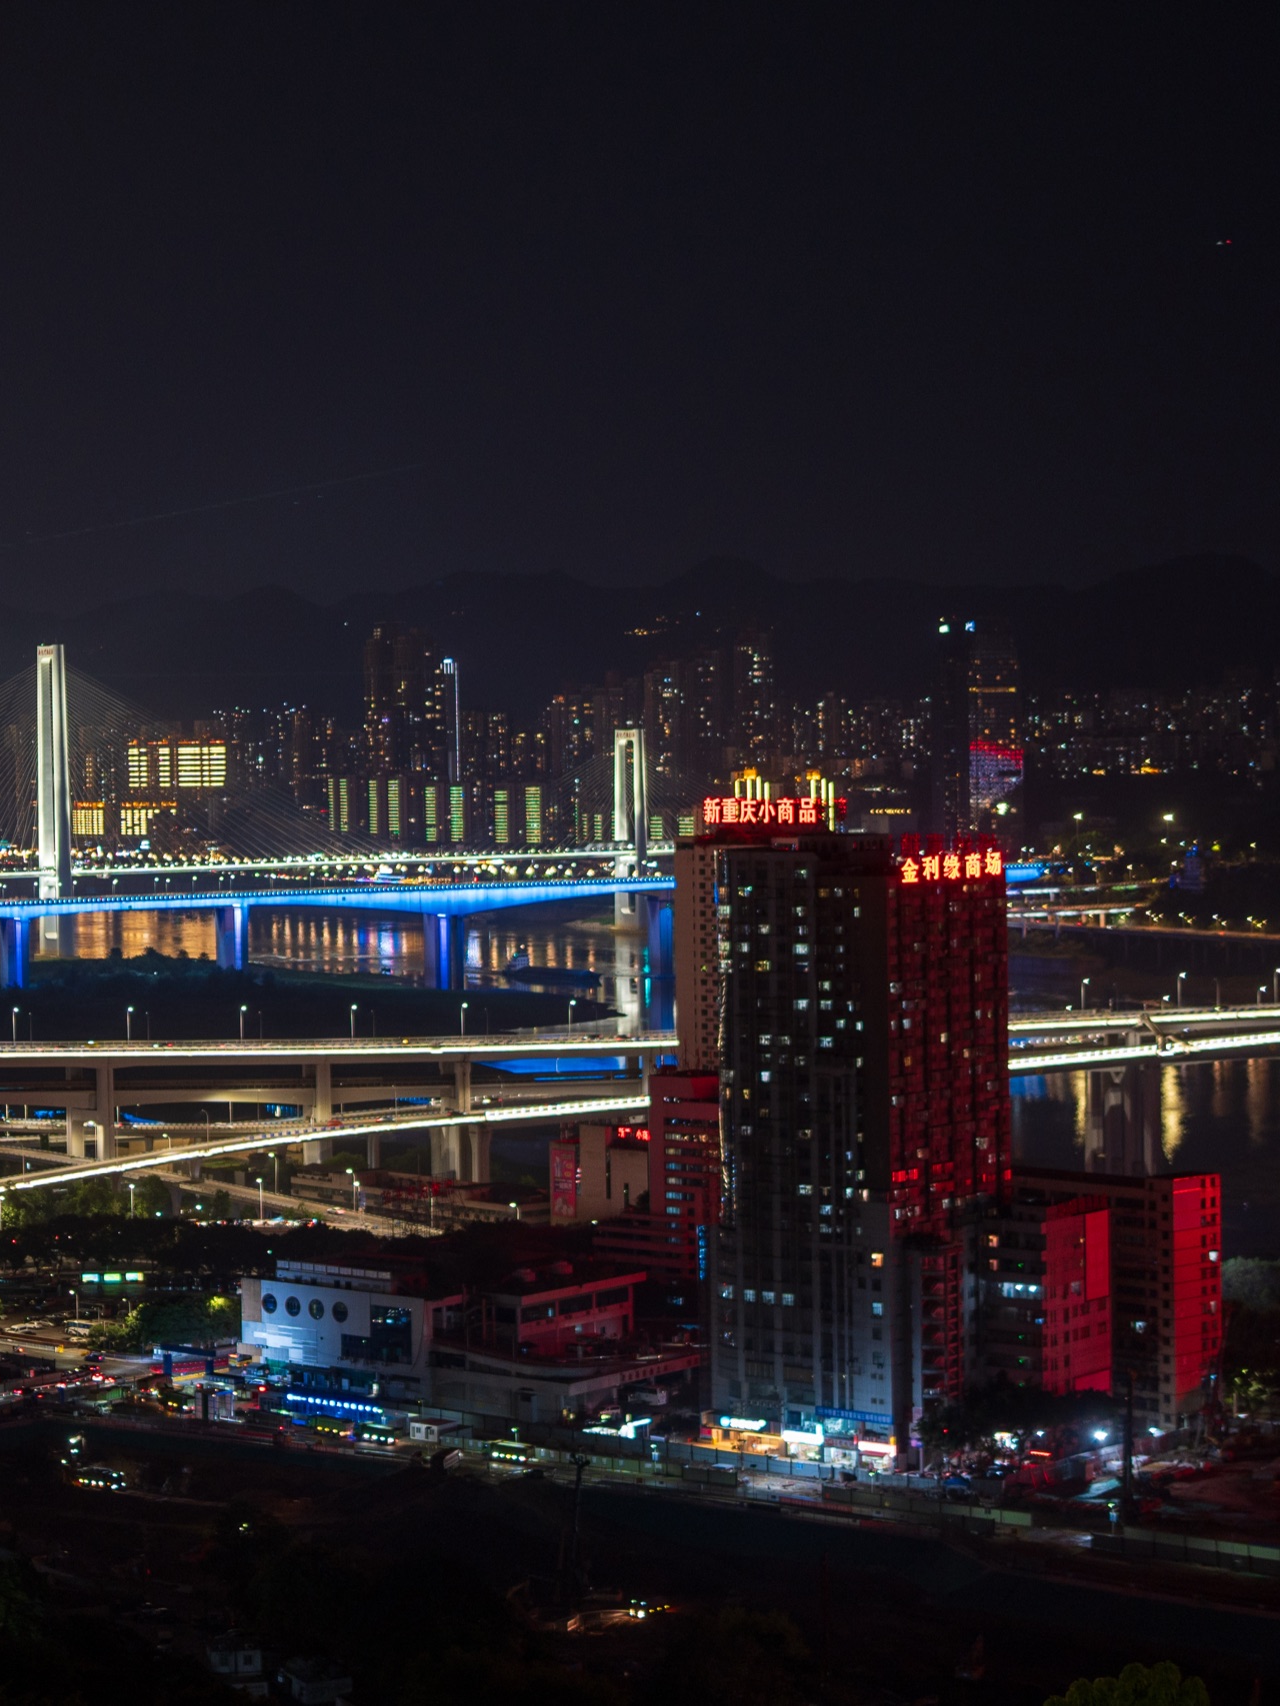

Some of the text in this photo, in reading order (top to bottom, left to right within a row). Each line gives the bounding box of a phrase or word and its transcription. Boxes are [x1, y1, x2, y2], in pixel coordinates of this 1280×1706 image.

[703, 797, 817, 824] 新重庆小商品
[900, 851, 1003, 884] 金利缘商场
